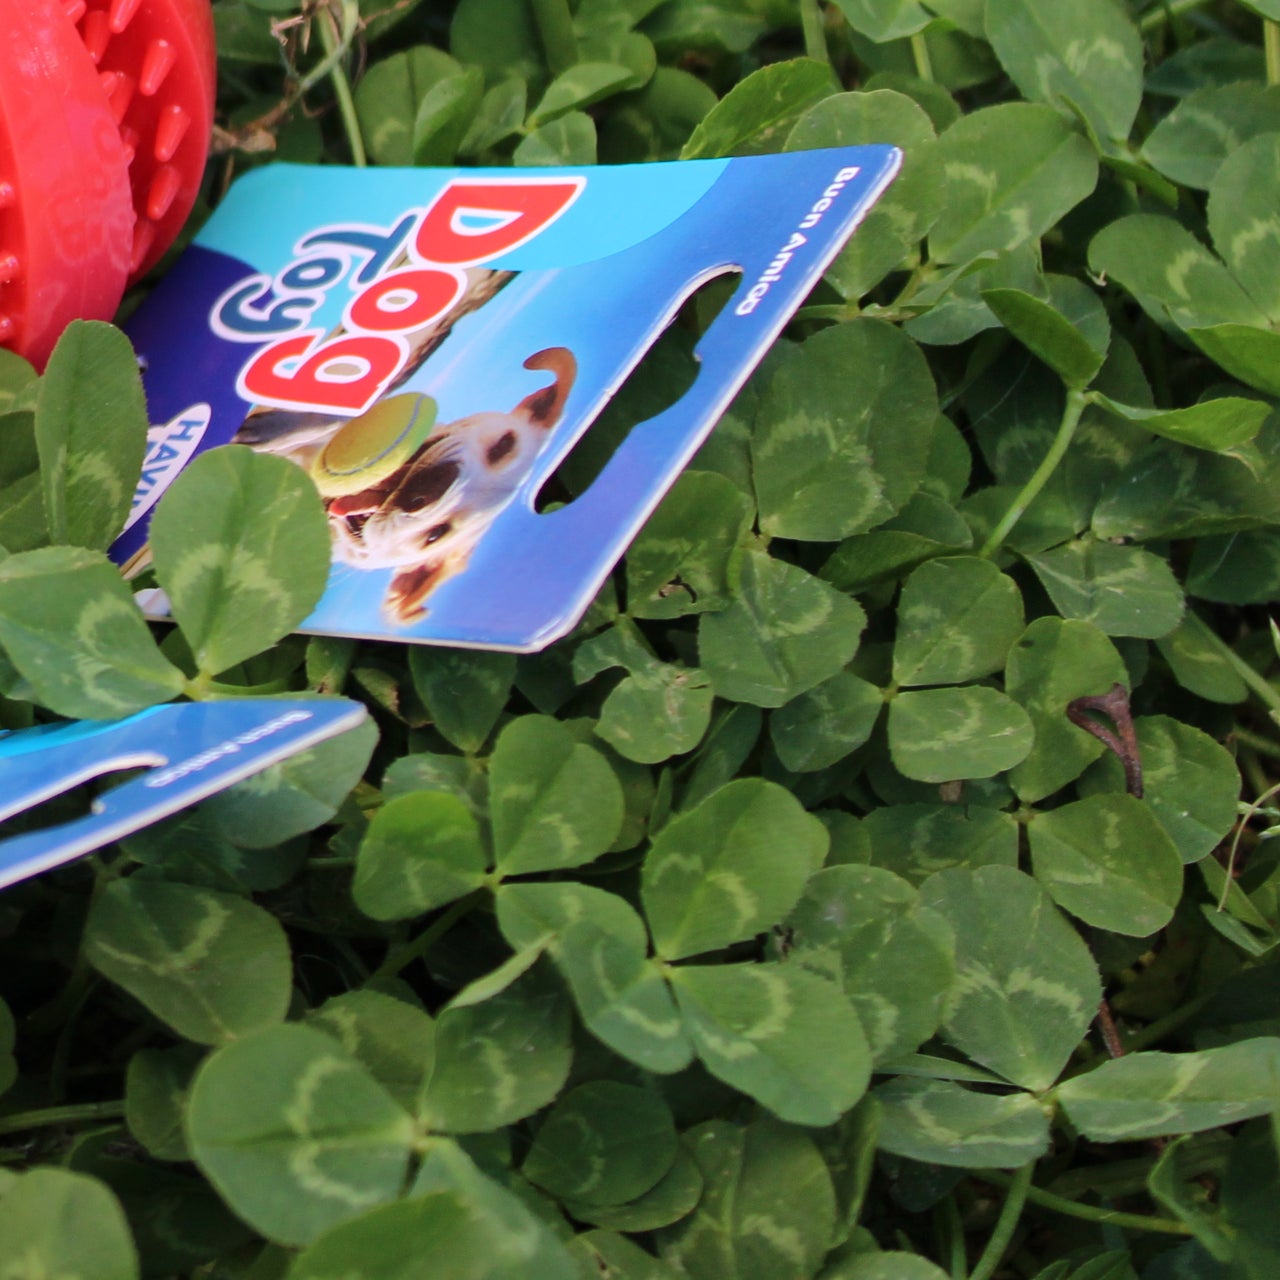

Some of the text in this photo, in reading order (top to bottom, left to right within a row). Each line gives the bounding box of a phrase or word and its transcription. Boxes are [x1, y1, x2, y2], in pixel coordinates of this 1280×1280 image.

[798, 166, 861, 229] Buen
[217, 212, 421, 334] Toy
[240, 180, 582, 412] Dog
